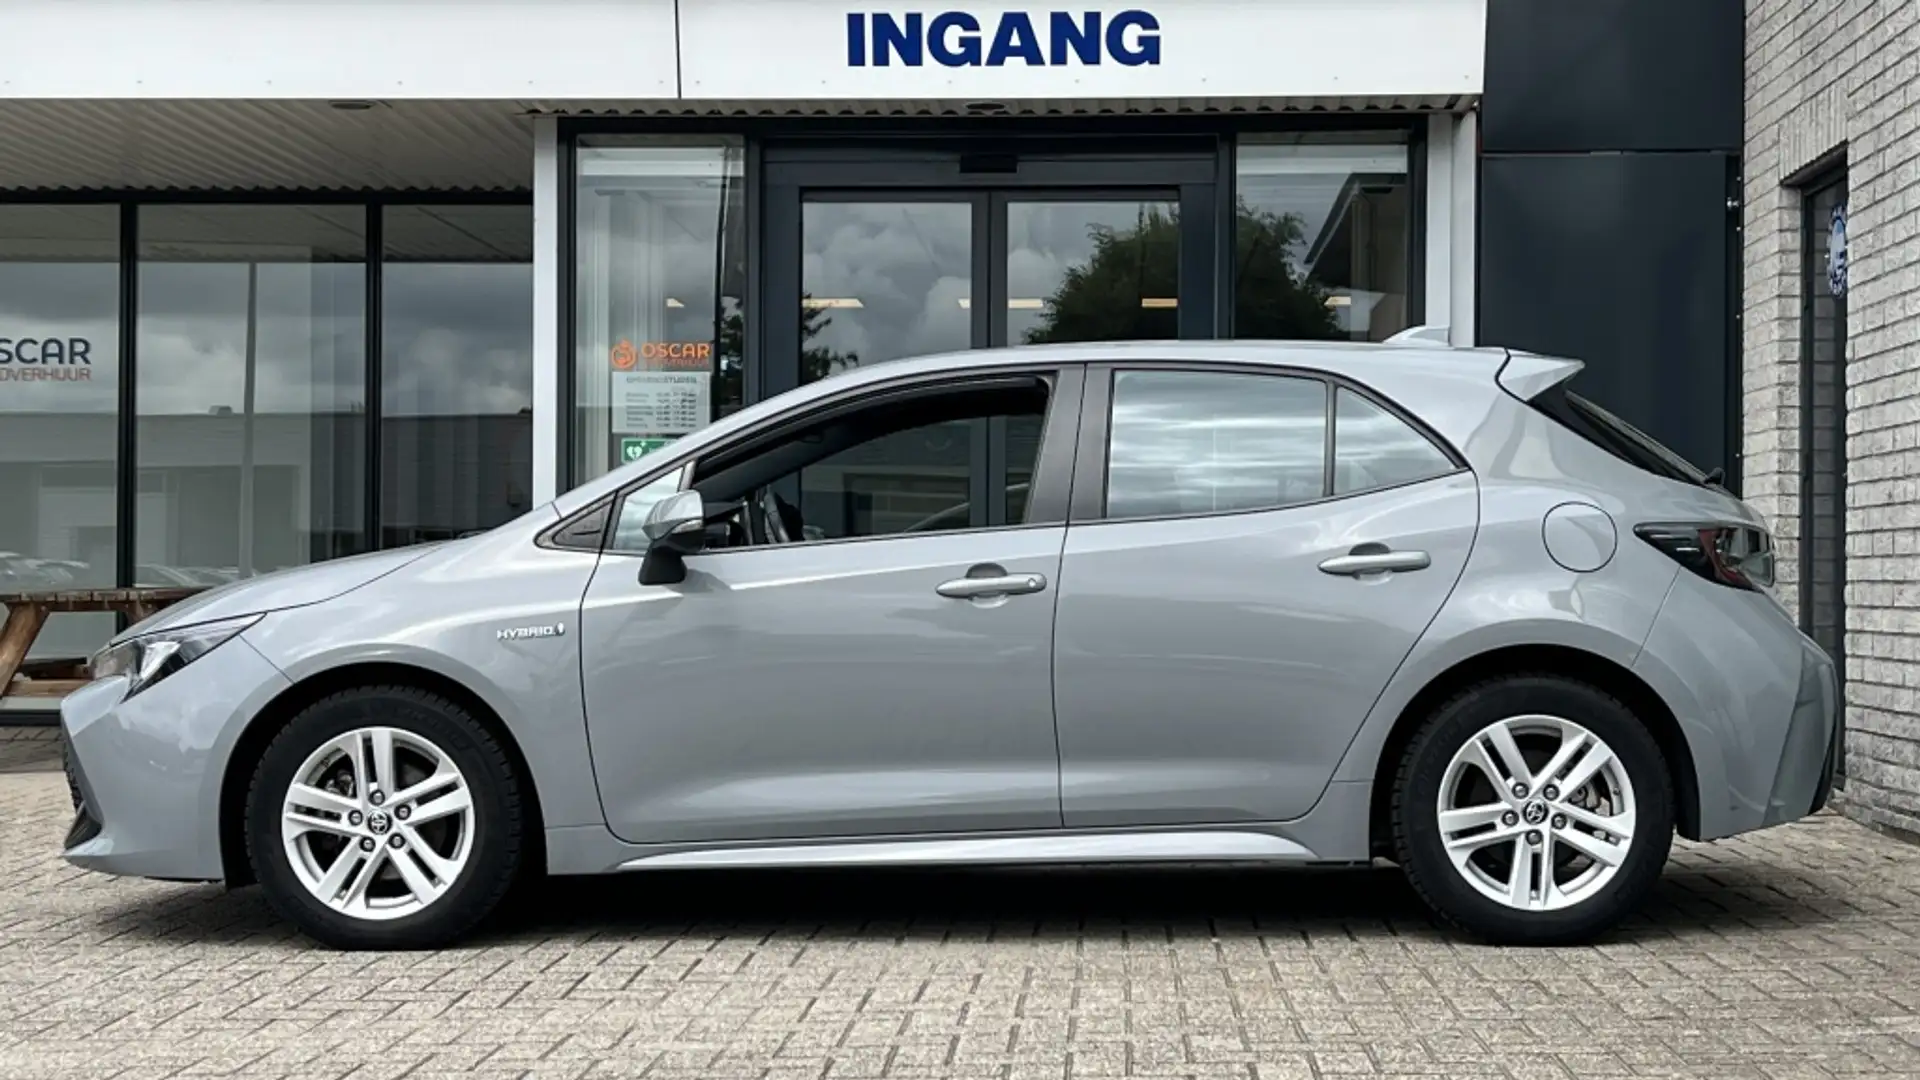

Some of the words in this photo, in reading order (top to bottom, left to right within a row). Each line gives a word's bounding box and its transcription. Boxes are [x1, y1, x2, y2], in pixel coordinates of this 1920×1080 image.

[847, 10, 1160, 67] INGANG
[641, 342, 710, 359] OSCAR
[496, 626, 554, 639] HYBRID
